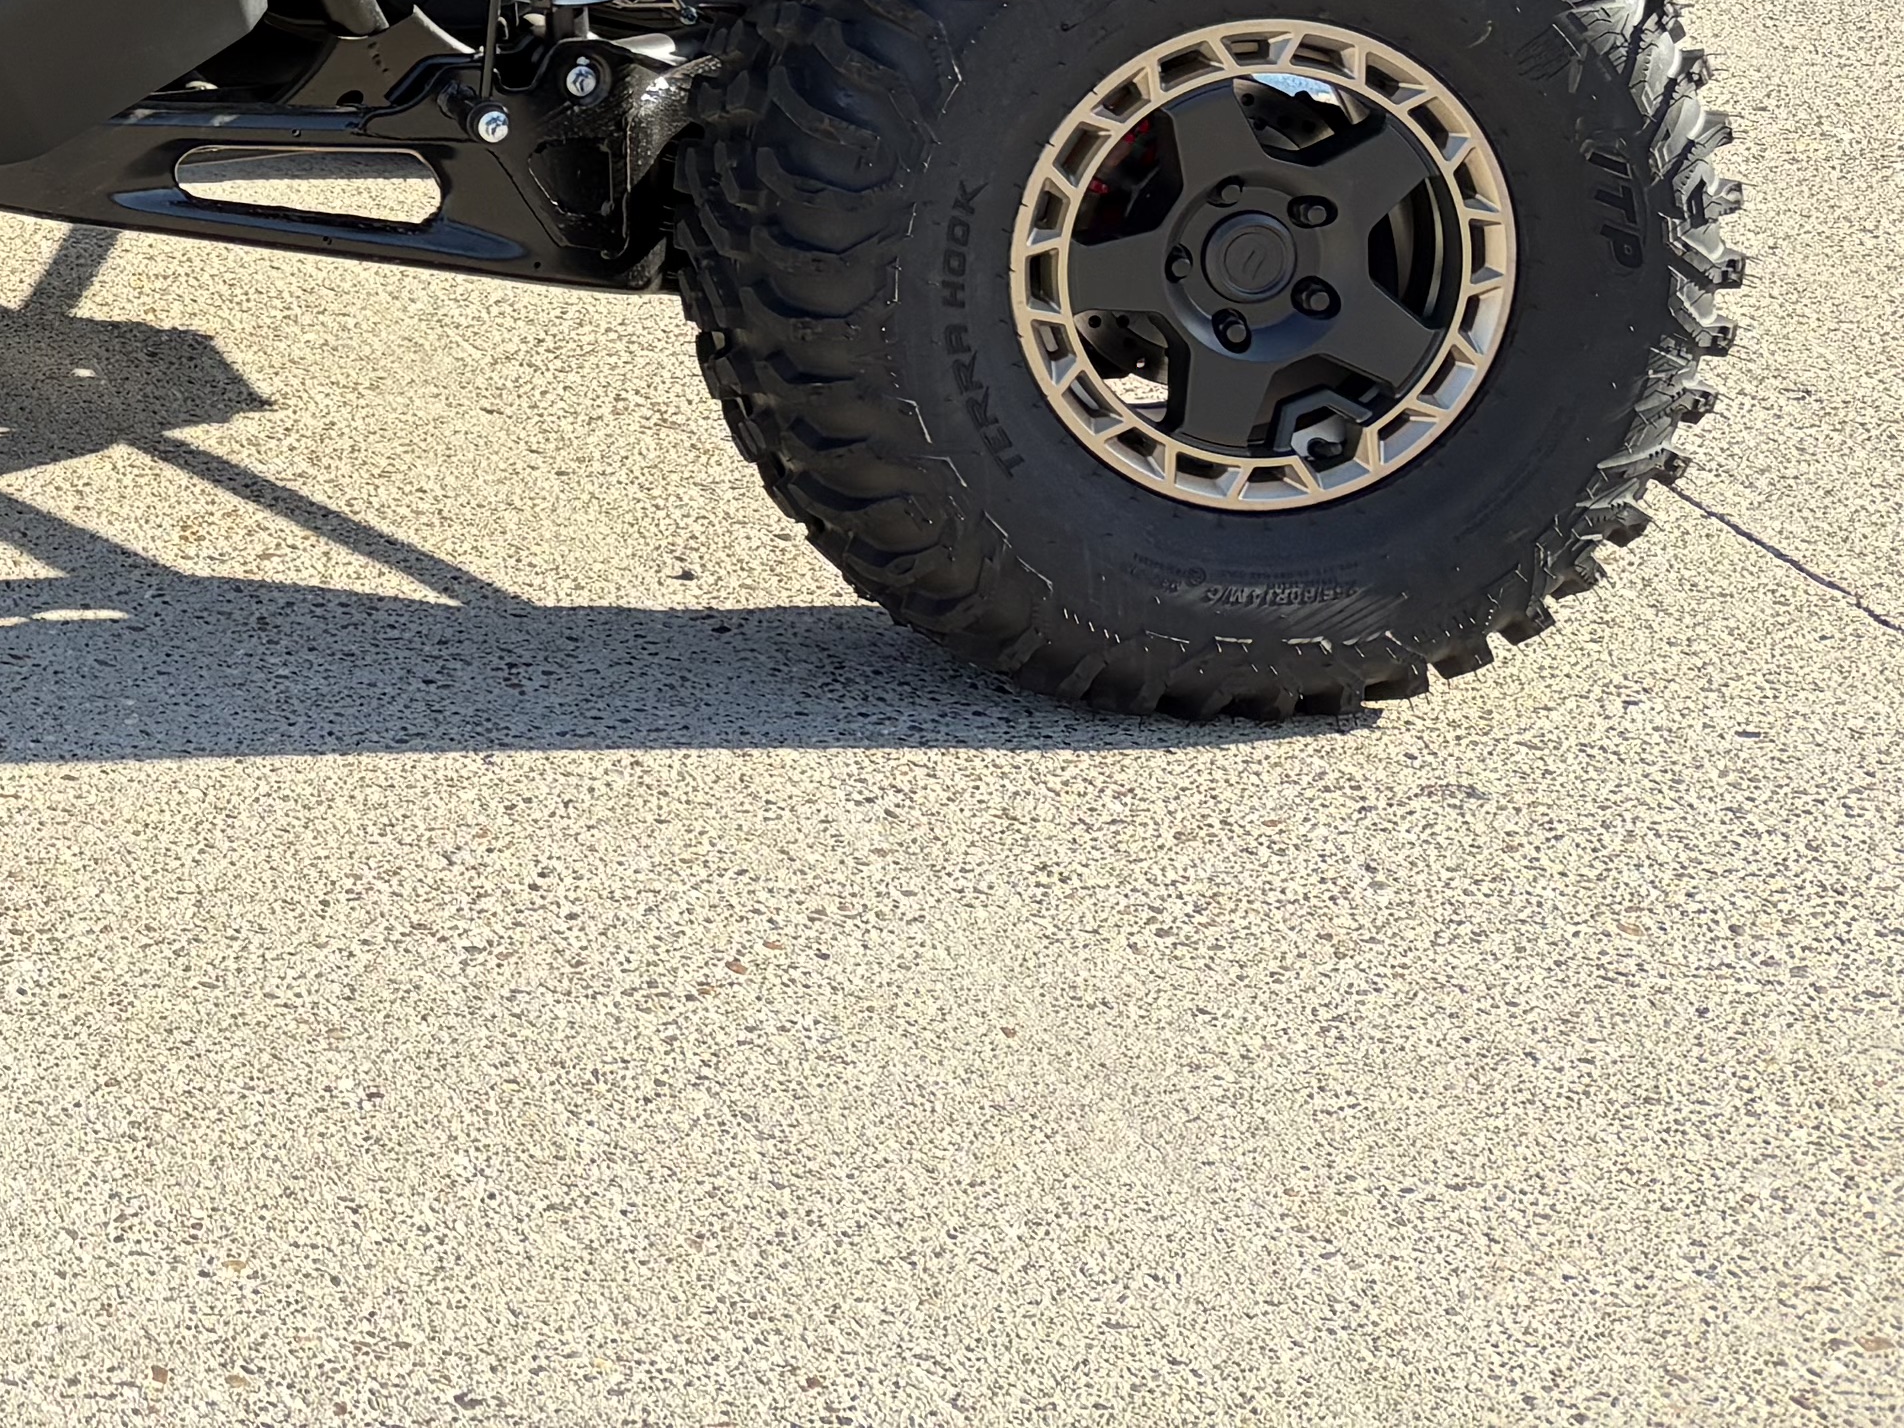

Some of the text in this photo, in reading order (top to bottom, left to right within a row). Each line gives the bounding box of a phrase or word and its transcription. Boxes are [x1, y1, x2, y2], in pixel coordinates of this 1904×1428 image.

[1584, 151, 1644, 269] ITP
[942, 179, 1026, 479] TERRA HOOK
